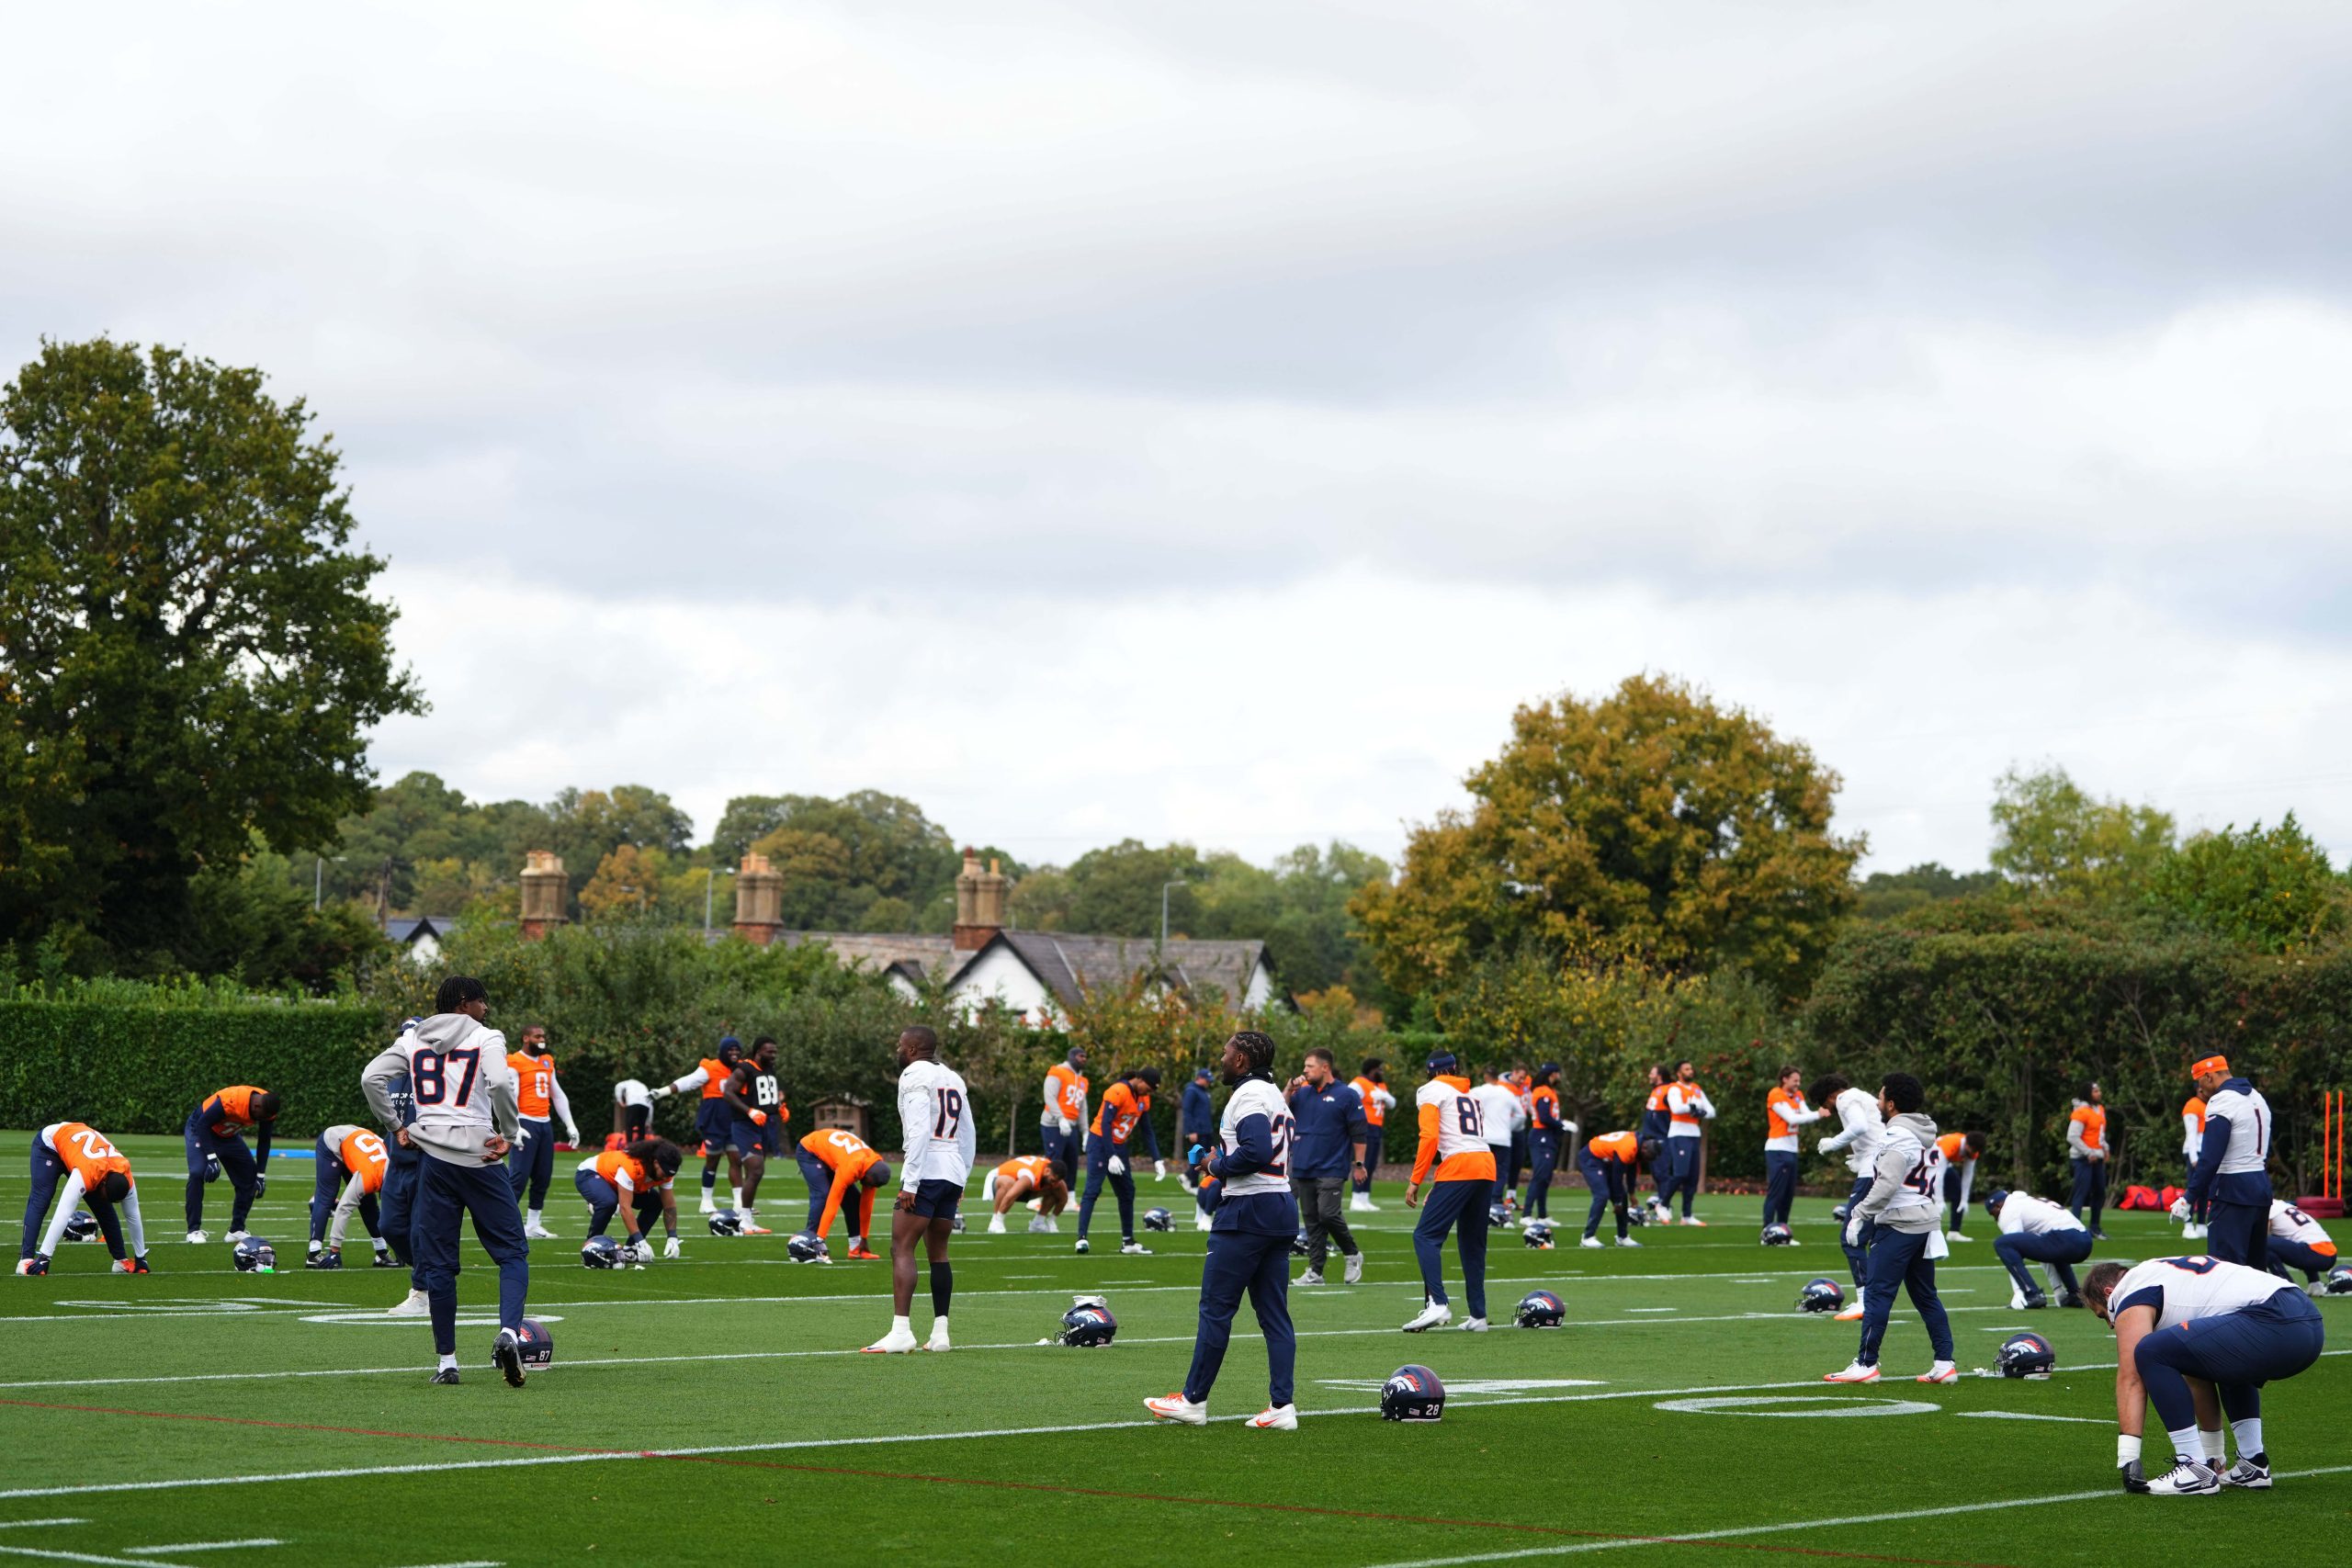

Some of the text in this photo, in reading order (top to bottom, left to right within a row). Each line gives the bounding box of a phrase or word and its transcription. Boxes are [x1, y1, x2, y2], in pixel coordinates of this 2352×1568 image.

[413, 1047, 480, 1107] 87
[535, 1072, 548, 1099] 0
[934, 1088, 963, 1139] 19
[1456, 1096, 1484, 1138] 81
[2254, 1108, 2263, 1156] 1
[538, 1351, 550, 1361] 87
[1425, 1404, 1440, 1416] 28
